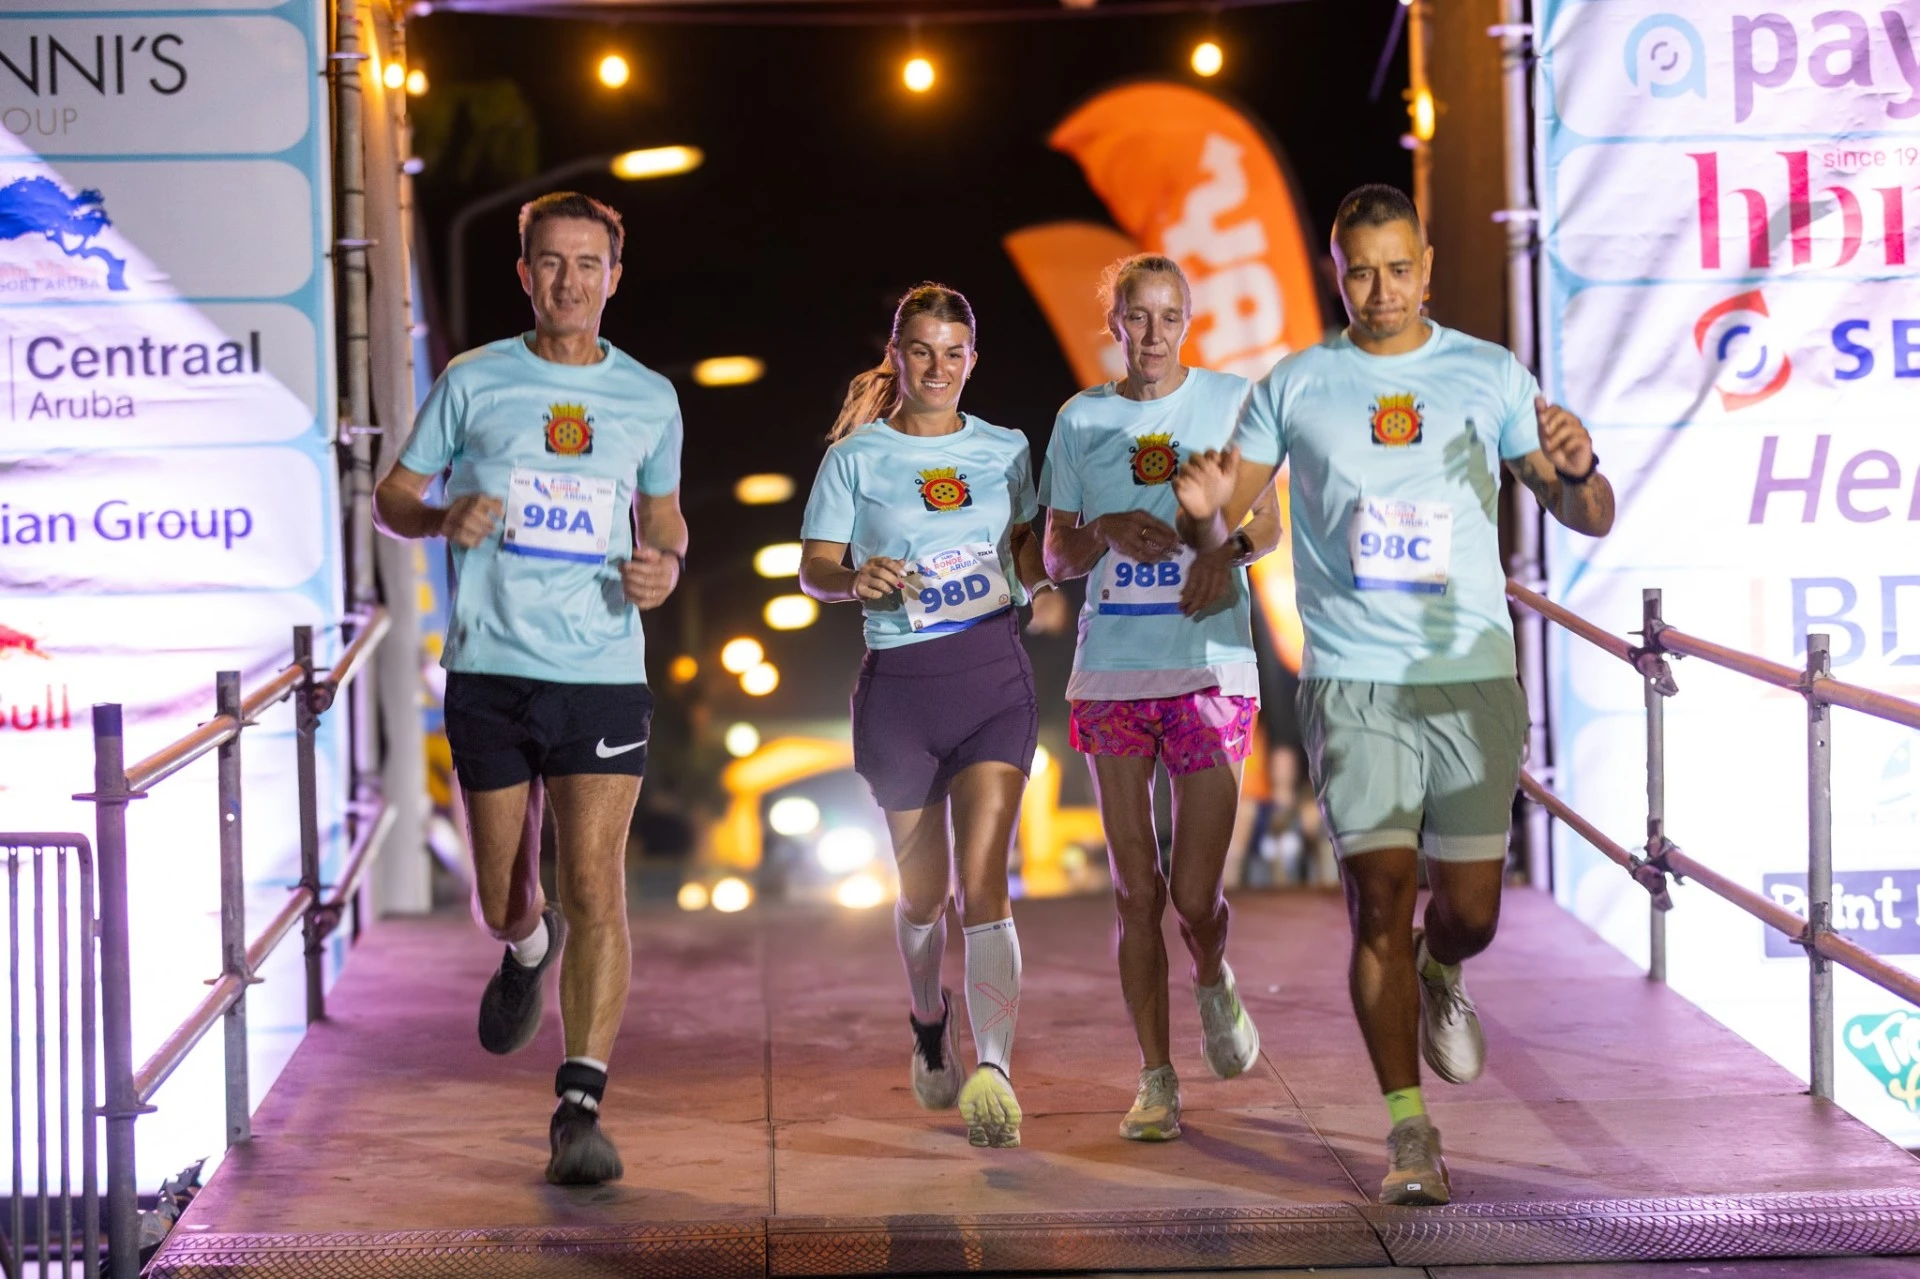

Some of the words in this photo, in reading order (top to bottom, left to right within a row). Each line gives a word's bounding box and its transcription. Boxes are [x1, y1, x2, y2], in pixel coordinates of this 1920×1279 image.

[1731, 10, 1920, 124] pay
[3, 107, 77, 135] OUP
[1823, 149, 1887, 168] since
[26, 331, 261, 380] Centraal
[28, 389, 135, 421] Aruba
[1747, 434, 1920, 525] He
[1, 503, 76, 544] ian
[93, 500, 253, 550] Group
[523, 504, 595, 535] 98A
[1360, 532, 1432, 561] 98C
[934, 556, 963, 570] RONDE
[950, 559, 978, 572] ARUBA
[1115, 562, 1181, 587] 98B
[919, 573, 991, 614] 98D
[0, 684, 71, 731] ull
[1770, 876, 1902, 930] Pint
